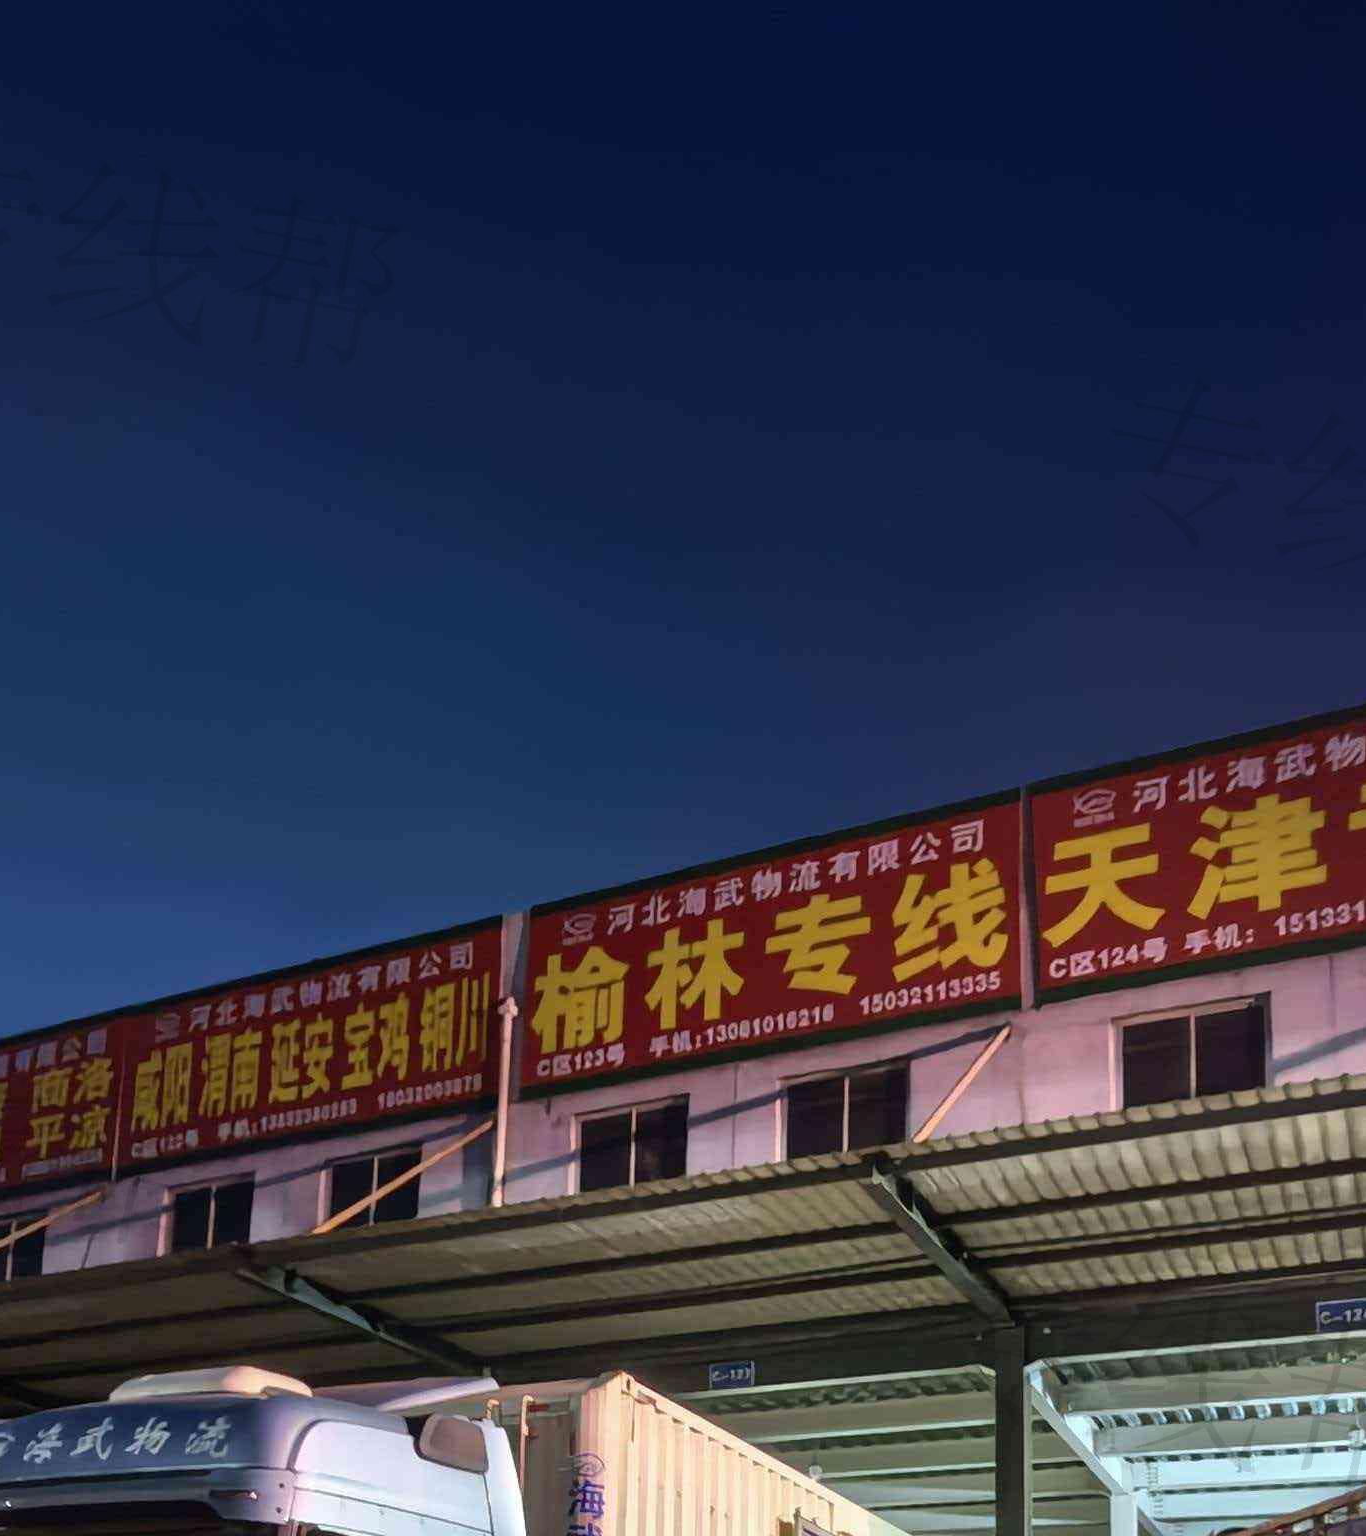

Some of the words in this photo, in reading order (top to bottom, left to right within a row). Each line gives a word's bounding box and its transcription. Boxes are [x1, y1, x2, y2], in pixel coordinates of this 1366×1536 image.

[607, 818, 986, 936] 河北海武物流有限公司
[531, 857, 1009, 1055] 榆林专线
[859, 970, 1002, 1015] 15032113335
[1049, 936, 1169, 979] C区124号
[199, 1027, 264, 1120] 渭南
[268, 1011, 334, 1105] 延安
[341, 991, 411, 1091] 宝鸡
[420, 971, 491, 1073] 铜川
